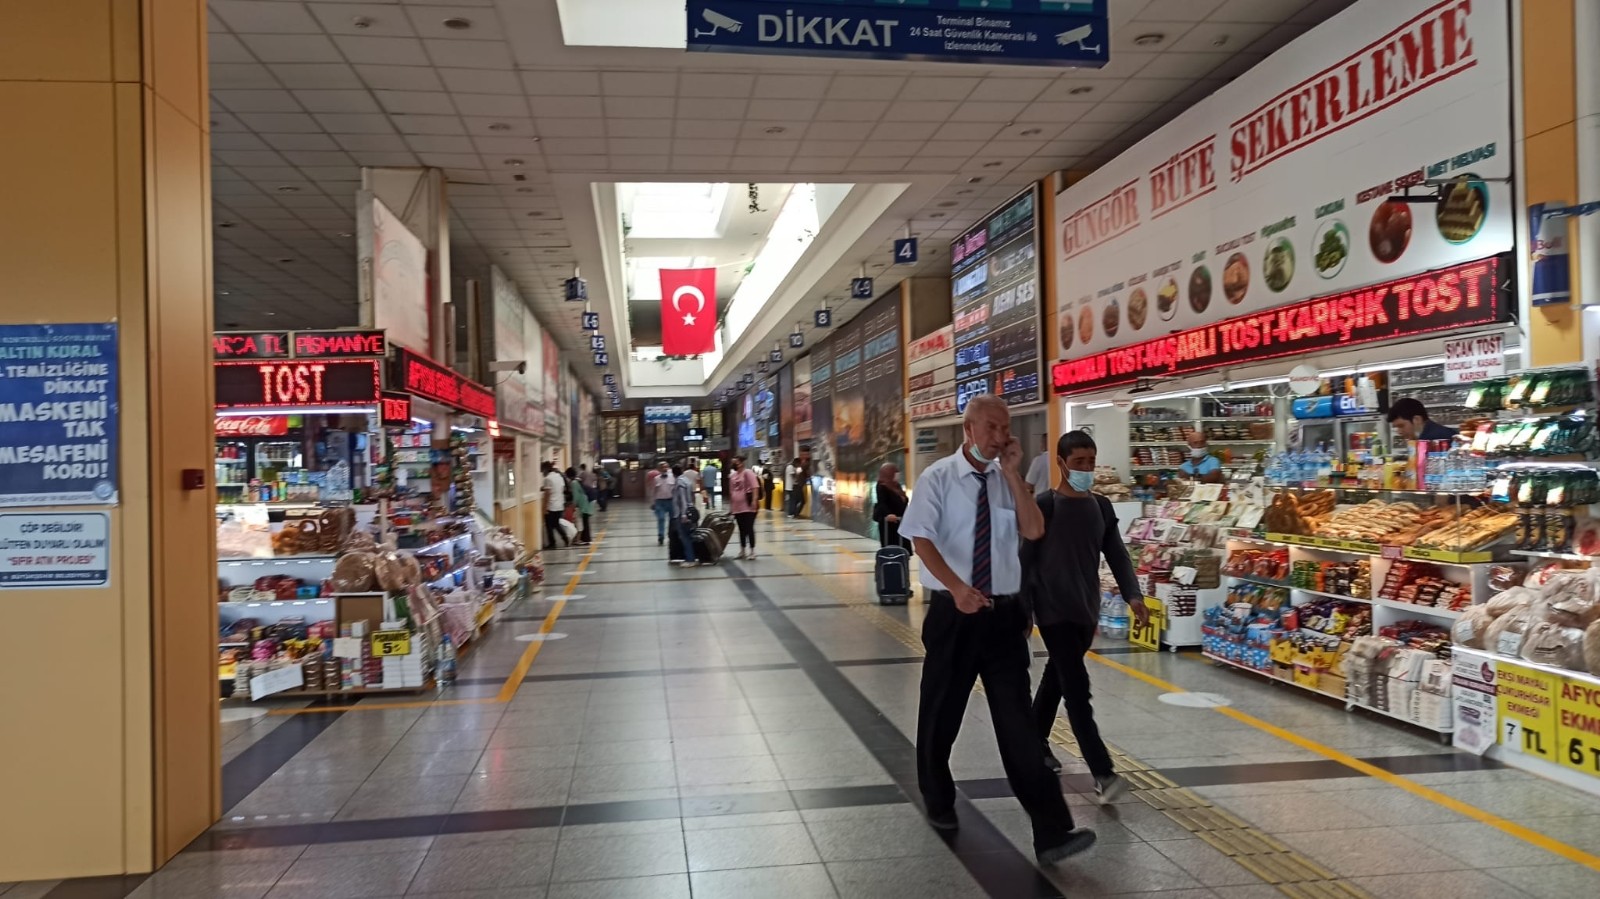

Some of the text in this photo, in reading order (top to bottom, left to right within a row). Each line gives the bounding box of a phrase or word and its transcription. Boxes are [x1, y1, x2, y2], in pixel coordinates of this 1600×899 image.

[758, 9, 899, 47] DİKKAT
[937, 15, 974, 26] Terminal
[909, 27, 921, 36] 24
[923, 27, 942, 37] Saat
[944, 28, 982, 39] Güvenlik
[984, 30, 1025, 41] Kamerası
[1063, 187, 1140, 254] GÜNGÖR
[1150, 142, 1215, 212] BÜFE
[1230, 2, 1473, 184] ŞEKERLEME
[899, 242, 912, 258] 4
[818, 312, 828, 324] 8
[1053, 354, 1107, 387] SUCUKLU
[1392, 265, 1489, 321] TOST
[47, 344, 102, 358] KURAL
[1446, 336, 1502, 359] SICAK TOST
[5, 361, 109, 378] TEMİZLİĞİNE
[44, 377, 109, 394] DİKKAT
[259, 364, 326, 402] TOST
[0, 395, 108, 422] MASKENİ
[382, 398, 409, 420] TOST
[62, 420, 106, 438] TAK
[0, 438, 109, 464] MESAFENİ
[43, 462, 109, 480] KORU!
[1132, 618, 1141, 640] 5
[1522, 727, 1547, 755] TL
[1569, 737, 1584, 765] 6
